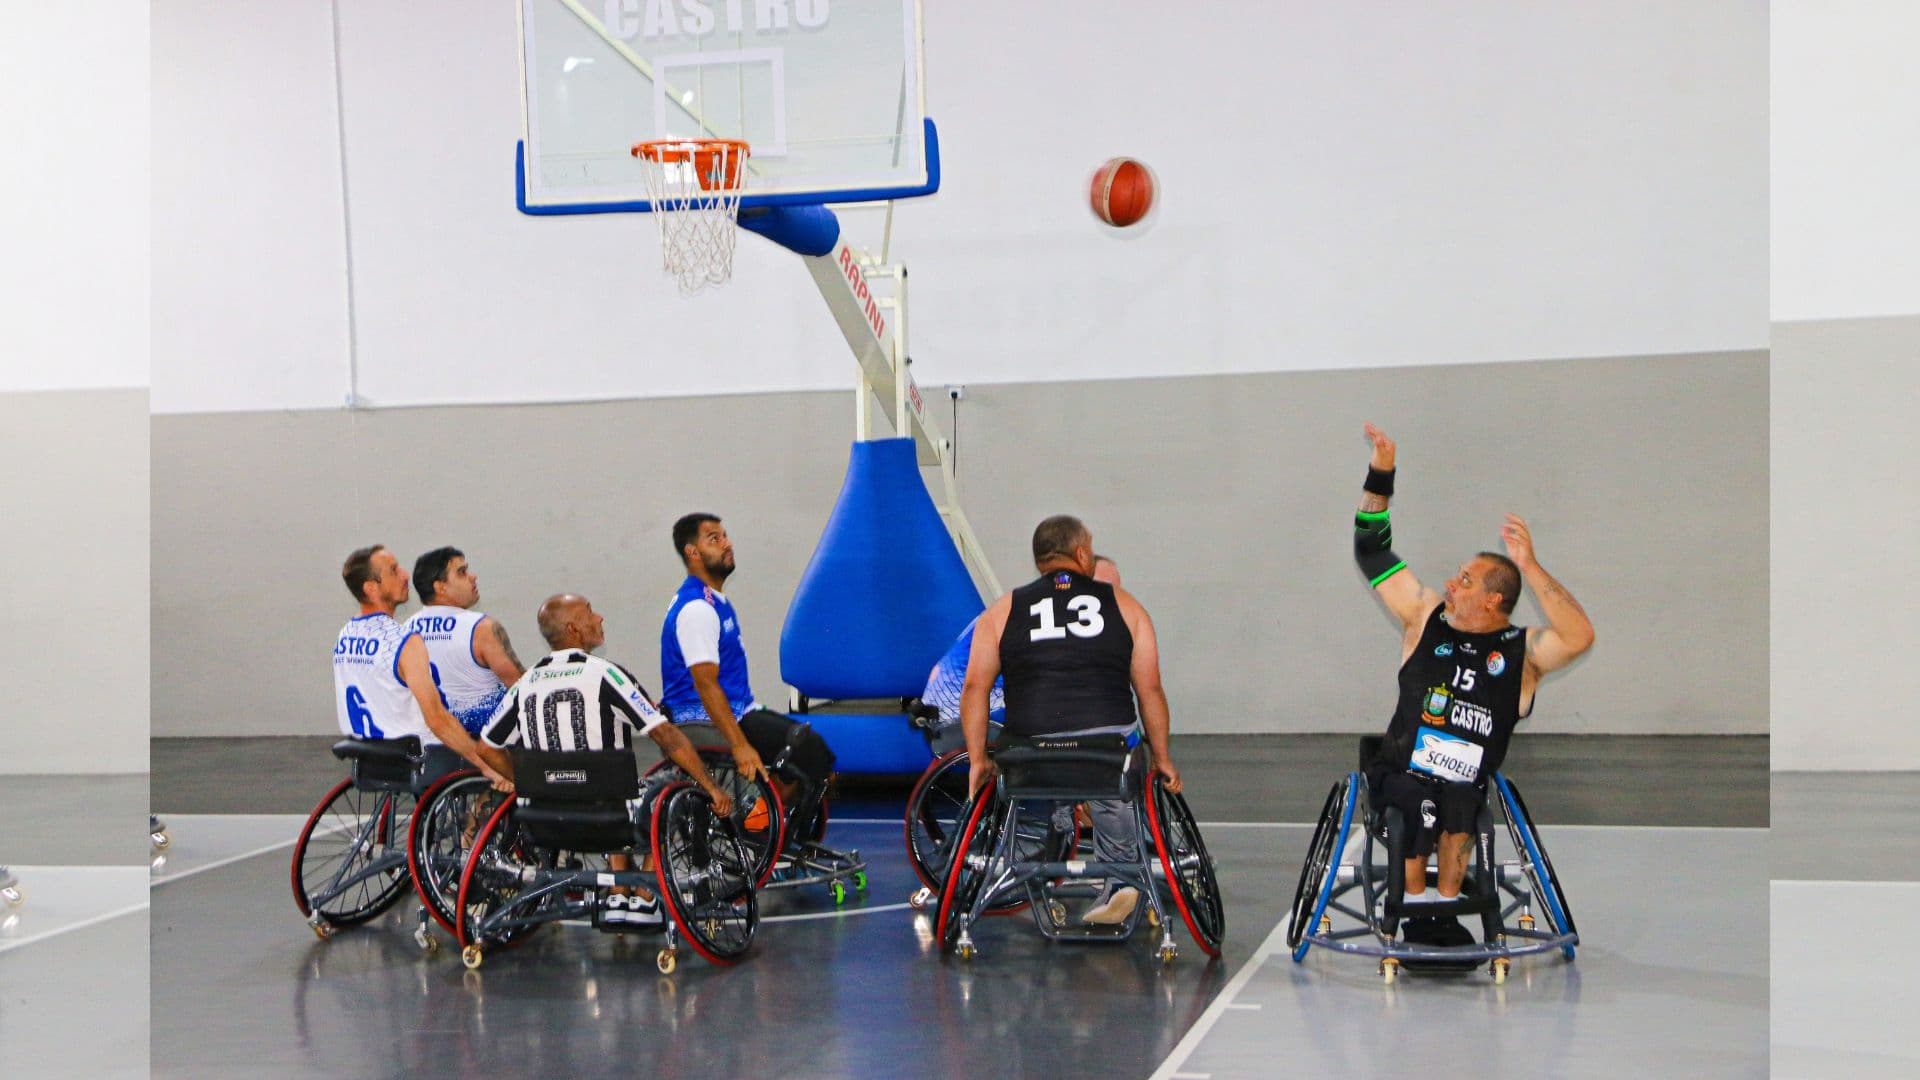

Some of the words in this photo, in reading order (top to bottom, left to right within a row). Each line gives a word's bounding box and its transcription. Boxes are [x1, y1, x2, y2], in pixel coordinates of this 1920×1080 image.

[604, 0, 830, 39] CASTRO
[839, 246, 885, 339] RAPINI
[410, 616, 457, 633] STRO
[1030, 594, 1105, 642] 13
[334, 636, 380, 656] ASTRO
[543, 666, 584, 680] Sicredi
[1452, 665, 1477, 691] 15
[345, 685, 384, 739] 6
[525, 688, 590, 751] 10
[1451, 705, 1493, 737] CASTRO
